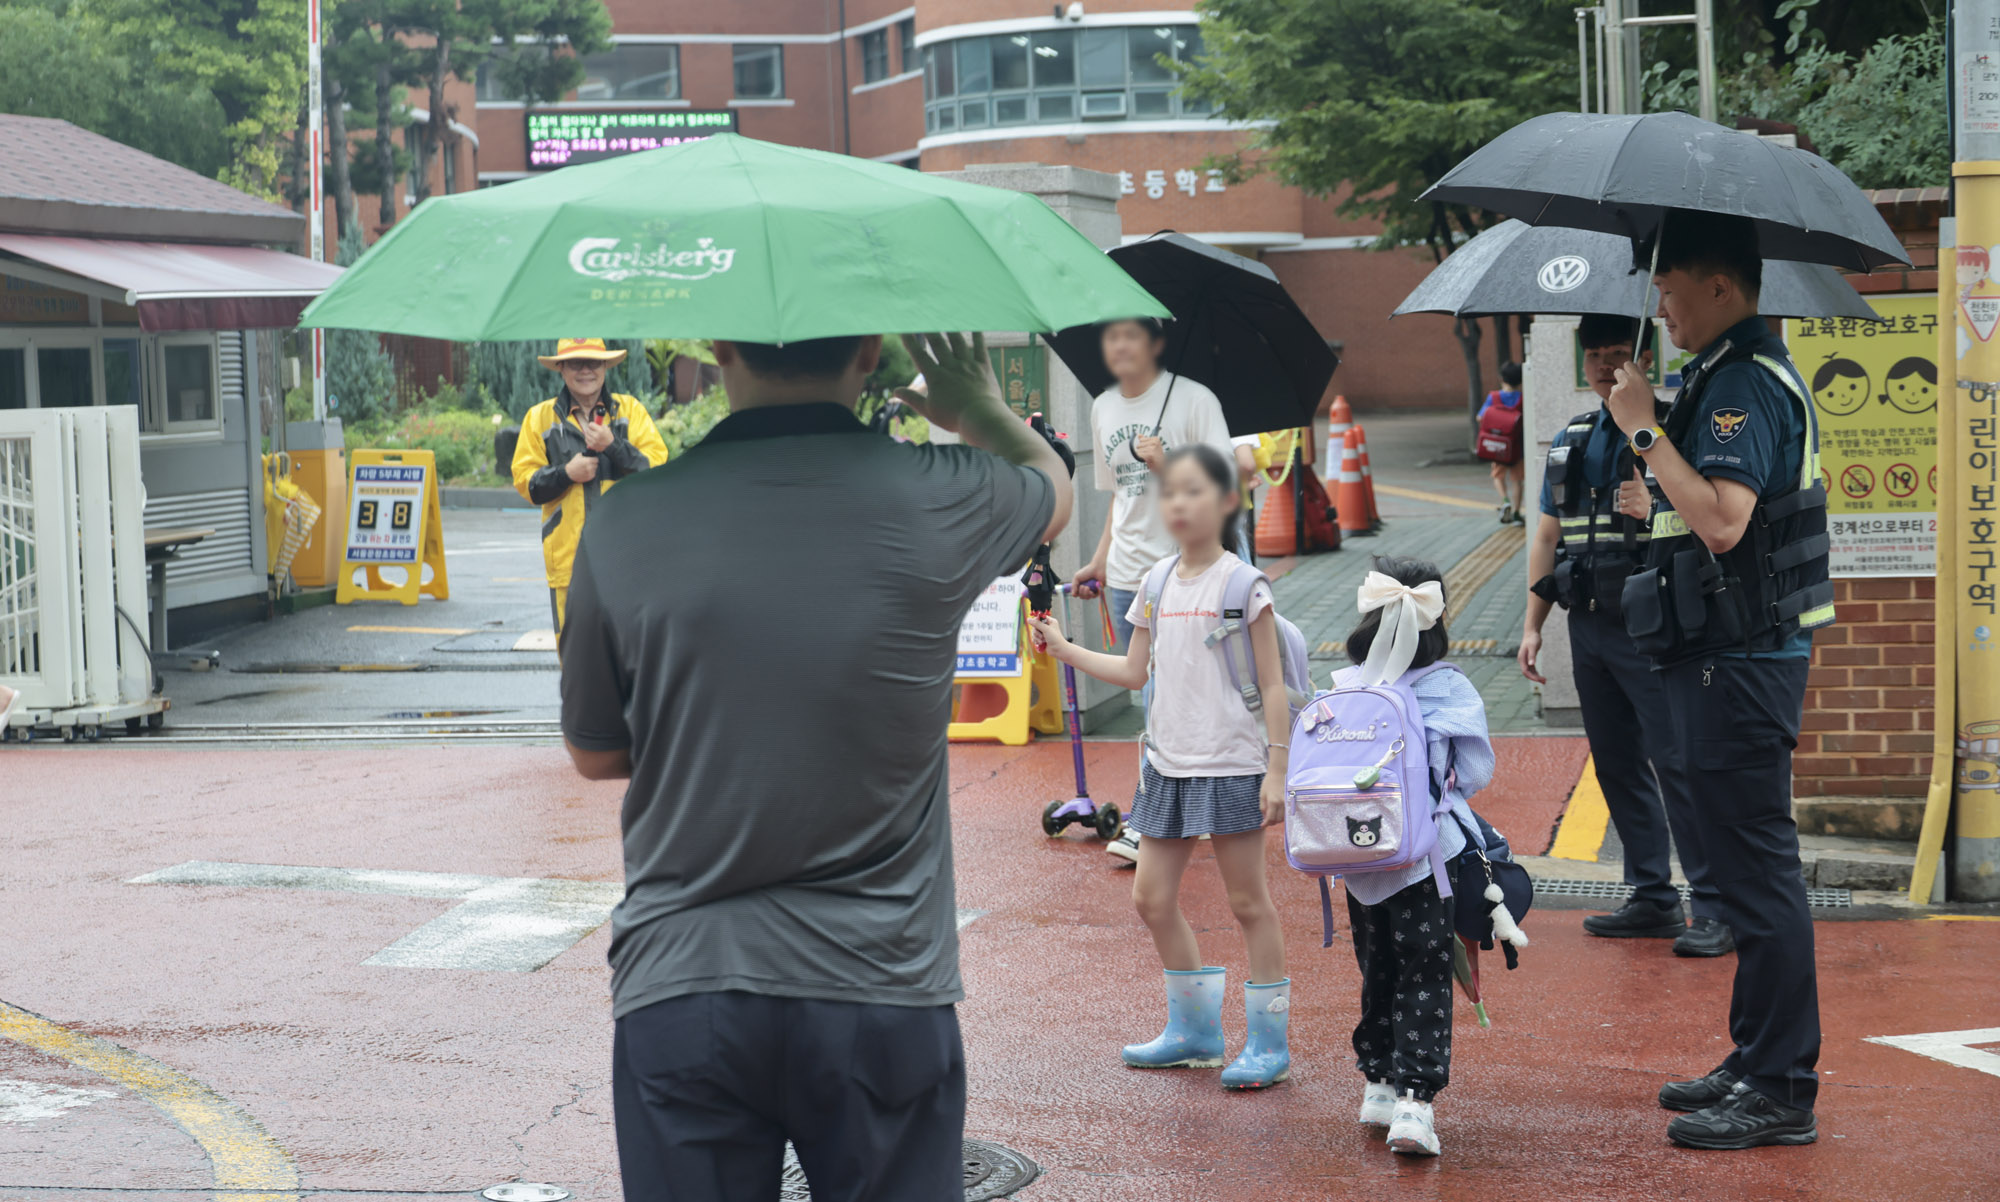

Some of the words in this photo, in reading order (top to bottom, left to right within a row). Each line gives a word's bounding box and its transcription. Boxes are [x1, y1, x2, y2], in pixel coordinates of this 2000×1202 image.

[568, 237, 736, 277] Carlsberg
[1973, 313, 1996, 323] SLOW
[1967, 387, 1998, 616] 어린이보호구역
[360, 503, 375, 526] 3
[394, 503, 409, 526] 8
[1652, 513, 1684, 536] LIC
[1832, 520, 1924, 536] 경계선으로부터
[1160, 608, 1219, 623] hampion
[1317, 724, 1377, 744] Kuromi
